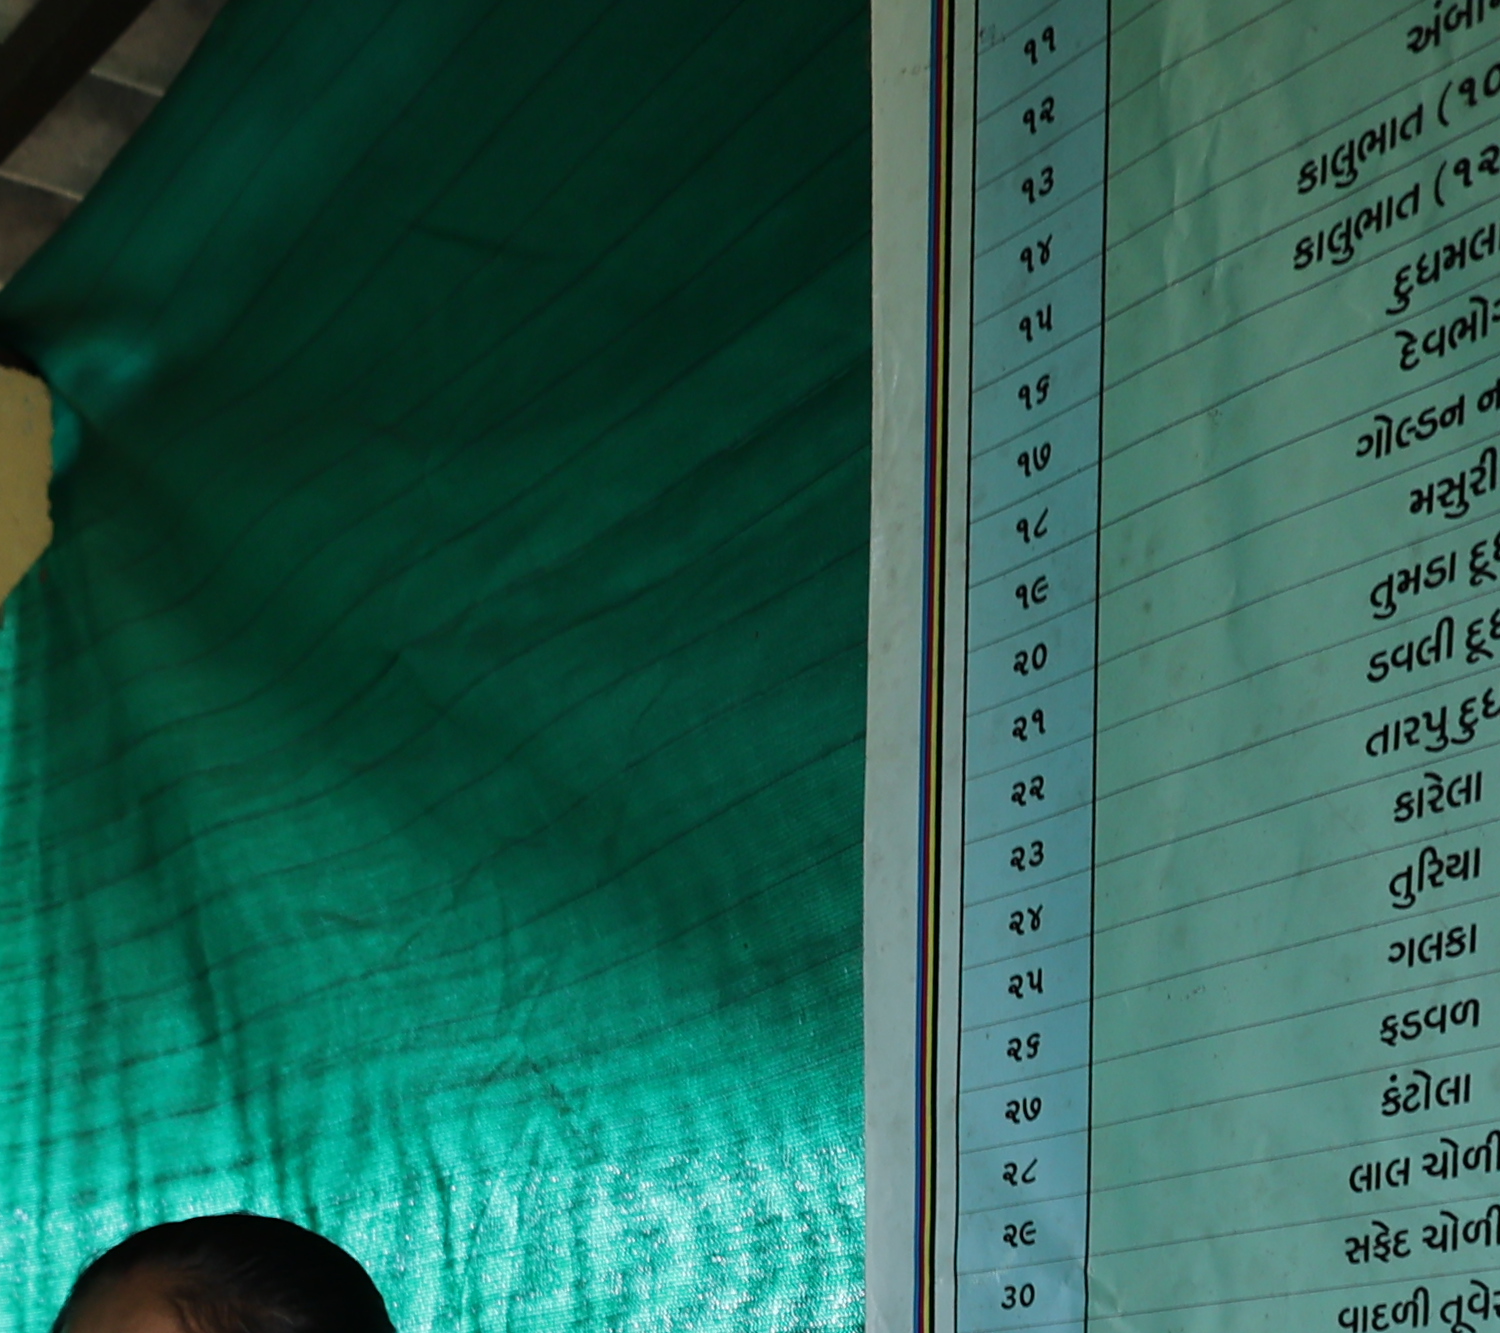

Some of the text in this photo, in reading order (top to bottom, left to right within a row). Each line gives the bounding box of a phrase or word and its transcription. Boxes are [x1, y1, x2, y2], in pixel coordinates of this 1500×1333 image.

[1024, 26, 1056, 65] ૧૧
[1298, 103, 1423, 194] કાલુભાત
[1021, 166, 1054, 204] ૧૩
[1294, 183, 1420, 270] કાલુભાત
[1020, 235, 1052, 273] ૧૪
[1018, 374, 1050, 410] ૧૬
[1356, 395, 1465, 459] ગોલ્ડન
[1017, 442, 1051, 477] ૧૭
[1410, 446, 1497, 519] મસુરી
[1015, 575, 1048, 609] ૧૯
[1370, 551, 1456, 620] તુમડા
[1367, 616, 1454, 683] ડવલી
[1012, 709, 1045, 741] ૨૧
[1394, 771, 1482, 823] કારેલા
[1010, 840, 1044, 871] ૨૩
[1389, 846, 1480, 910] તુરિયા
[1009, 905, 1042, 935] ૨૪
[1388, 924, 1476, 967] ગલકા
[1007, 1033, 1040, 1062] ૨૬
[1005, 1097, 1041, 1124] ૨૭
[1382, 1069, 1470, 1117] કંટોલા
[1349, 1157, 1410, 1193] લાલ
[1003, 1220, 1036, 1248] ૨૯
[1345, 1220, 1411, 1264] સફેદ
[1338, 1286, 1429, 1333] વાદળી
